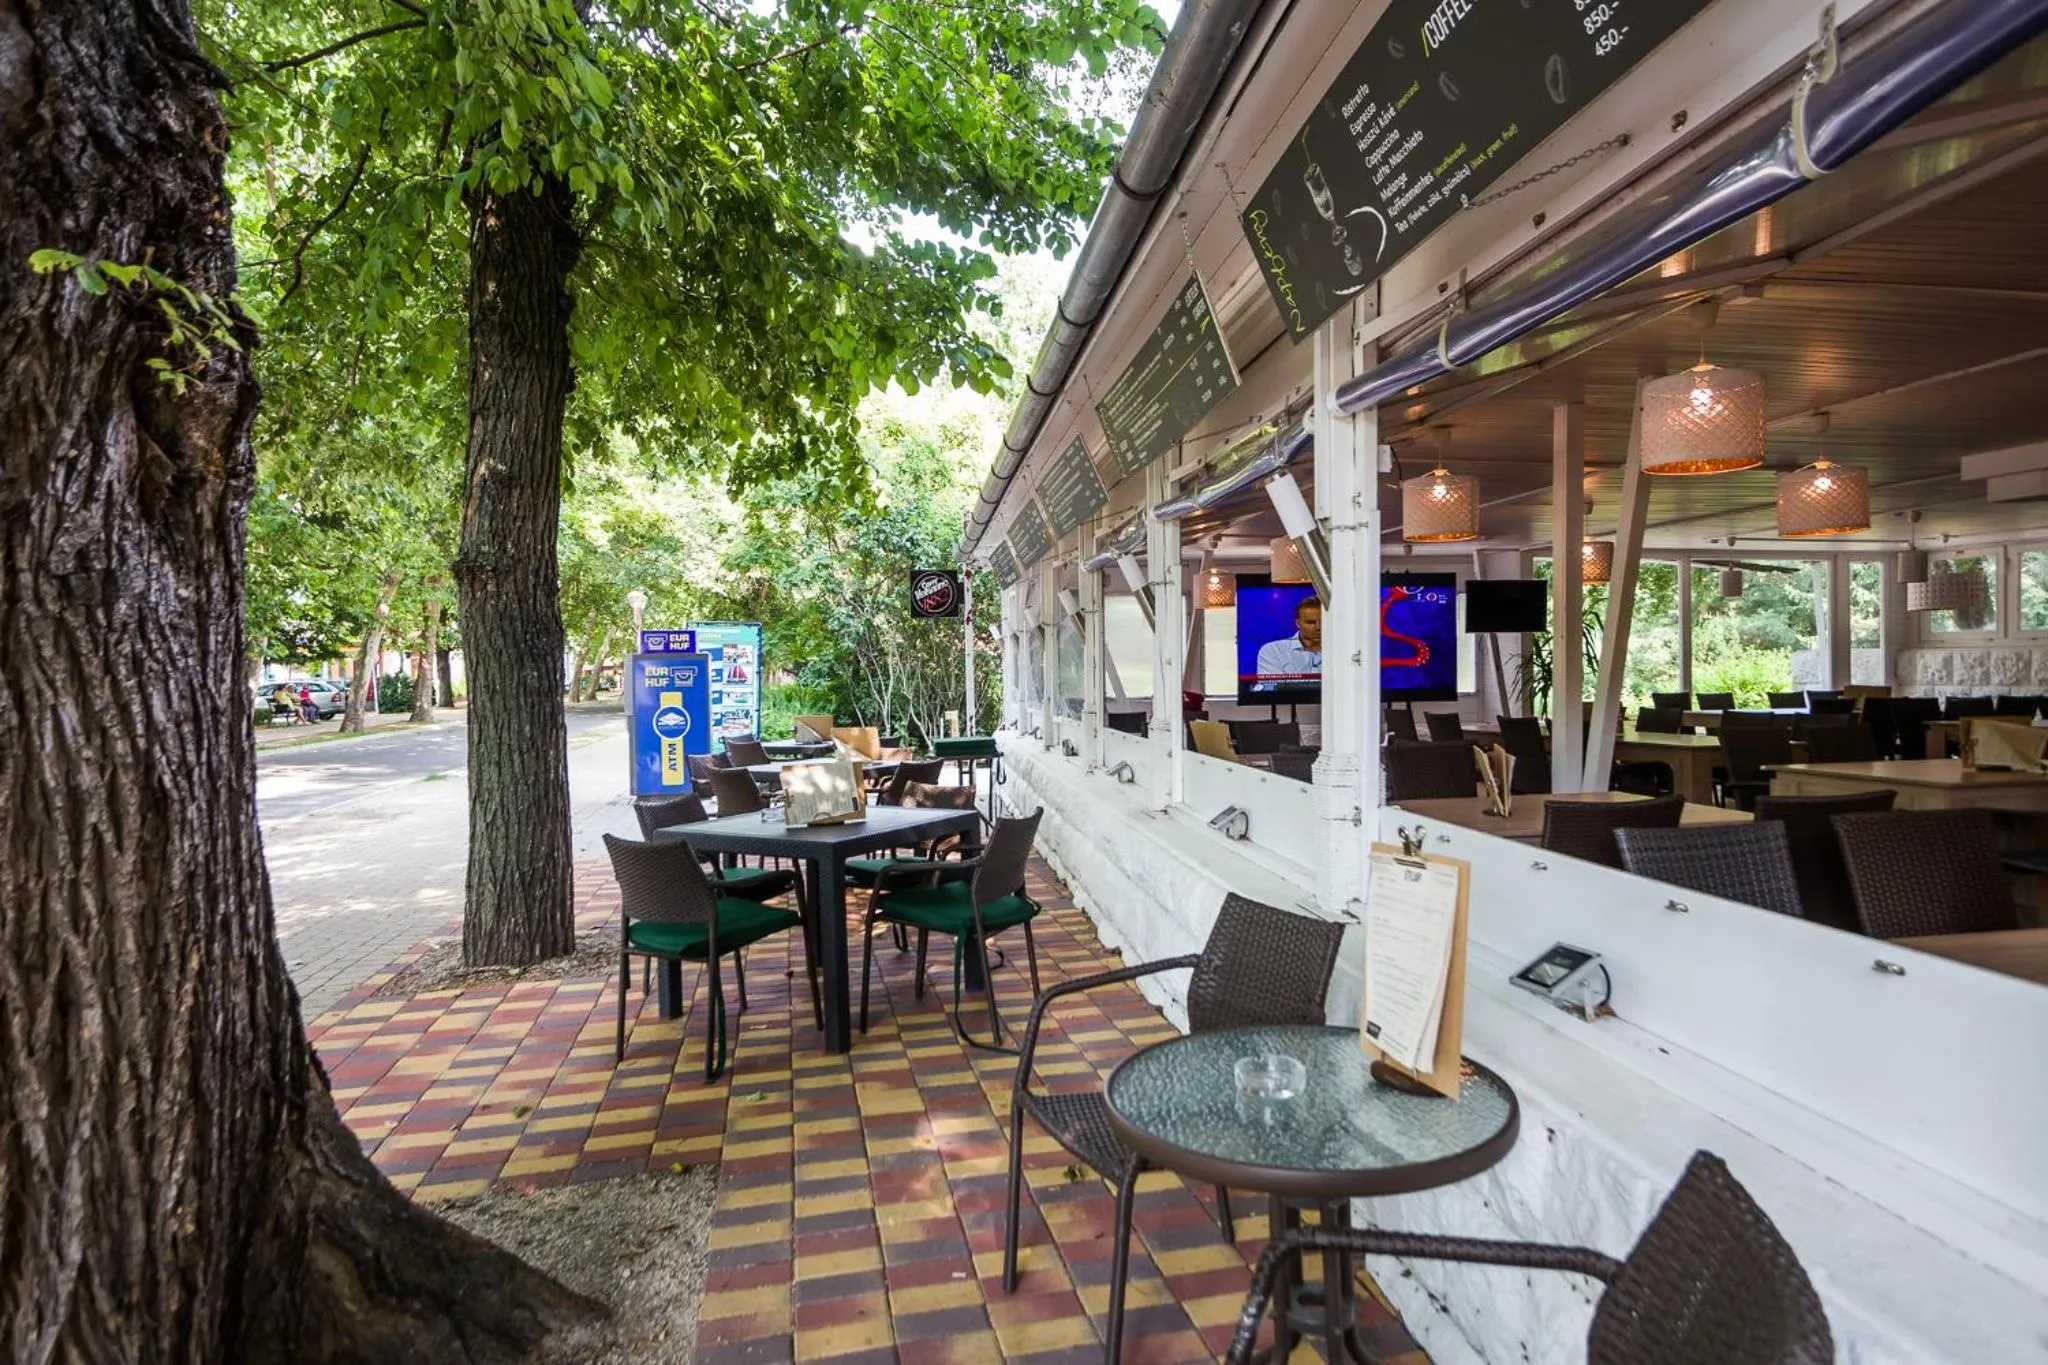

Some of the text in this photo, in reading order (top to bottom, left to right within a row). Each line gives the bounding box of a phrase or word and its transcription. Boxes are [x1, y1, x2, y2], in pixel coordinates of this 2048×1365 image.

[1583, 1, 1619, 34] 850.-
[1595, 26, 1629, 56] 450.-
[1341, 83, 1370, 119] Ristretto
[1349, 102, 1377, 136] Espresso
[1364, 128, 1400, 169] Cappuccino
[1371, 130, 1424, 186] Latte Macchiato
[1386, 171, 1435, 218] Koffeinmentes
[1394, 219, 1409, 233] Tea
[669, 633, 690, 641] EUR
[669, 642, 690, 650] HUF
[645, 666, 669, 676] EUR
[645, 677, 670, 688] HUF
[668, 743, 678, 772] ATM
